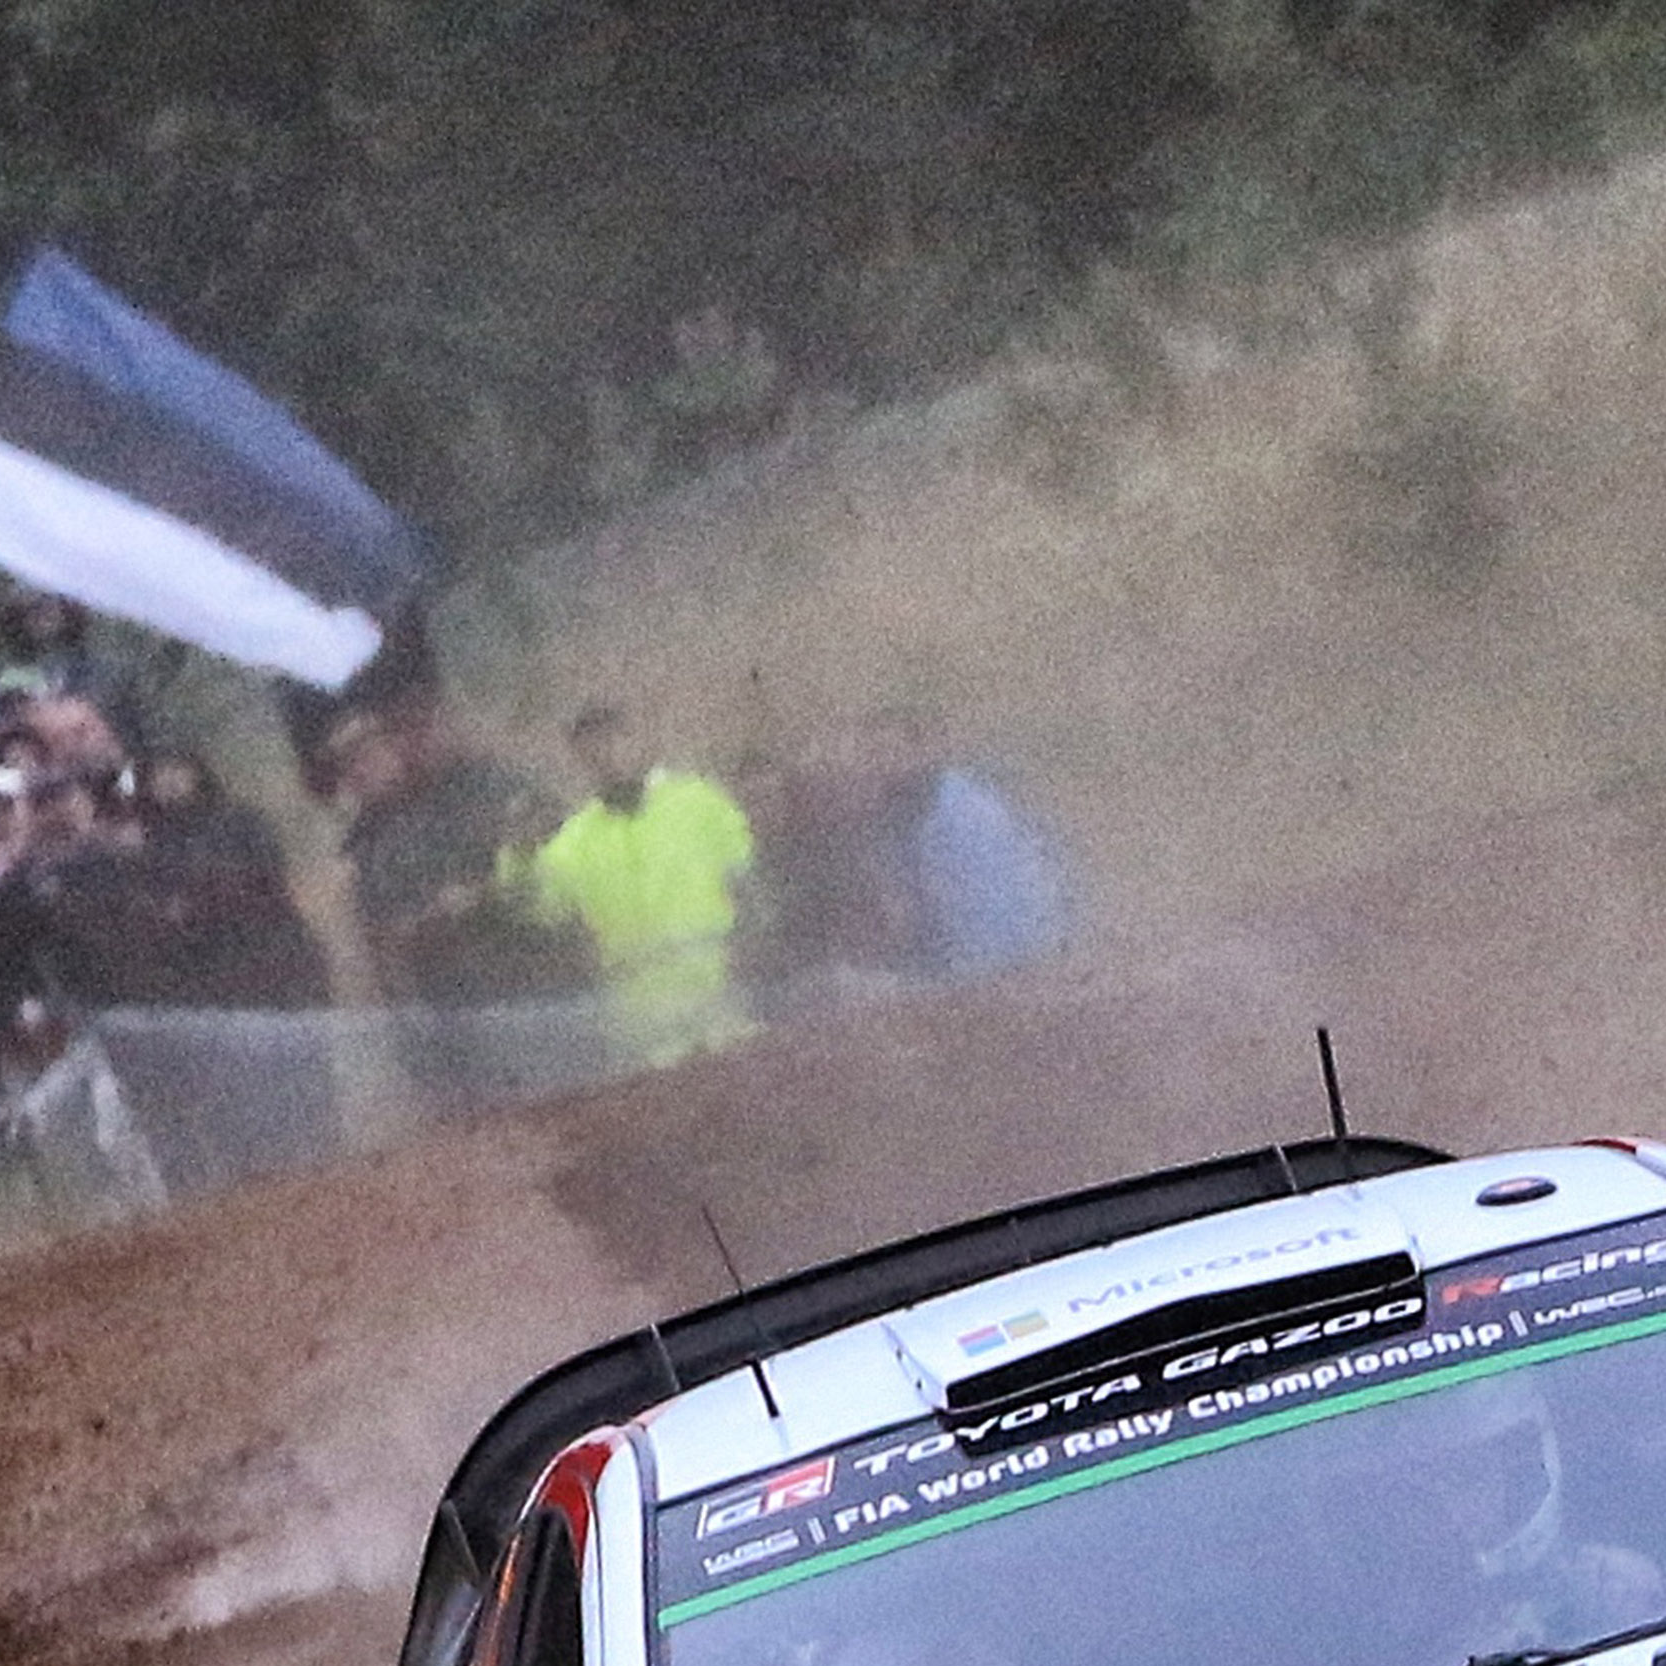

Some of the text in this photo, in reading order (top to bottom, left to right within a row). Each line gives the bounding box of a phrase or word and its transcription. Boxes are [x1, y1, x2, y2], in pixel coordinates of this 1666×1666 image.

[1068, 1227, 1360, 1313] Microsoft
[834, 1494, 911, 1534] FIA
[918, 1446, 1049, 1503] World
[1062, 1408, 1174, 1460] Rally
[1188, 1321, 1504, 1420] Championship
[854, 1374, 1141, 1476] TOYOTA
[1163, 1298, 1422, 1380] GAZOO
